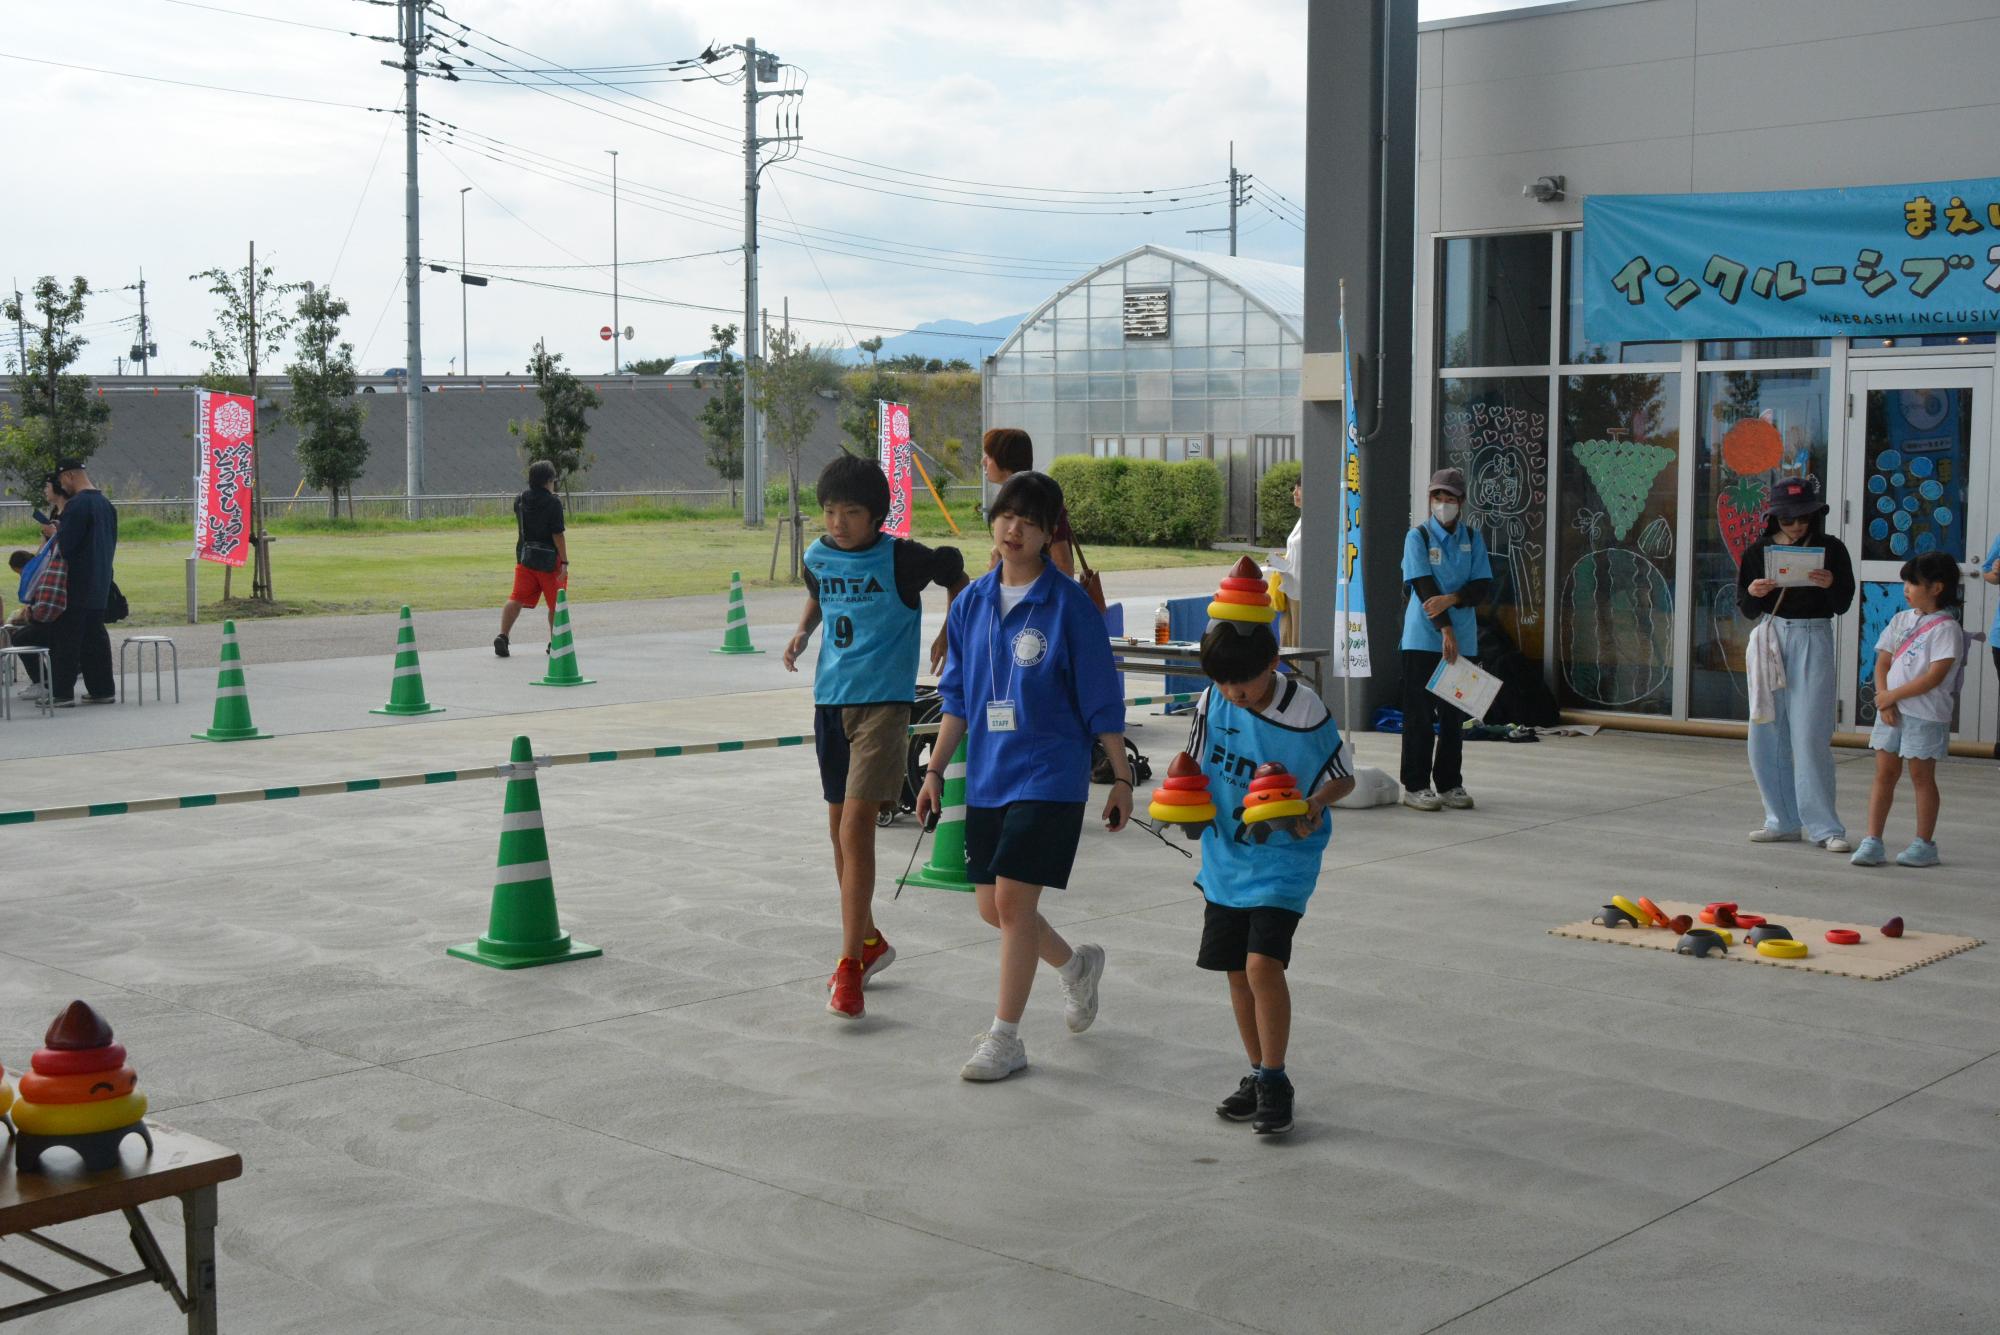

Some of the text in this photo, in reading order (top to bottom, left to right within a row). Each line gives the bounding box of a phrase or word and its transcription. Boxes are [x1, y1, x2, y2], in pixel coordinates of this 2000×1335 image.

[1819, 312, 1904, 325] MAEBASHI
[201, 400, 211, 466] MAEBASHI
[834, 616, 854, 649] 9
